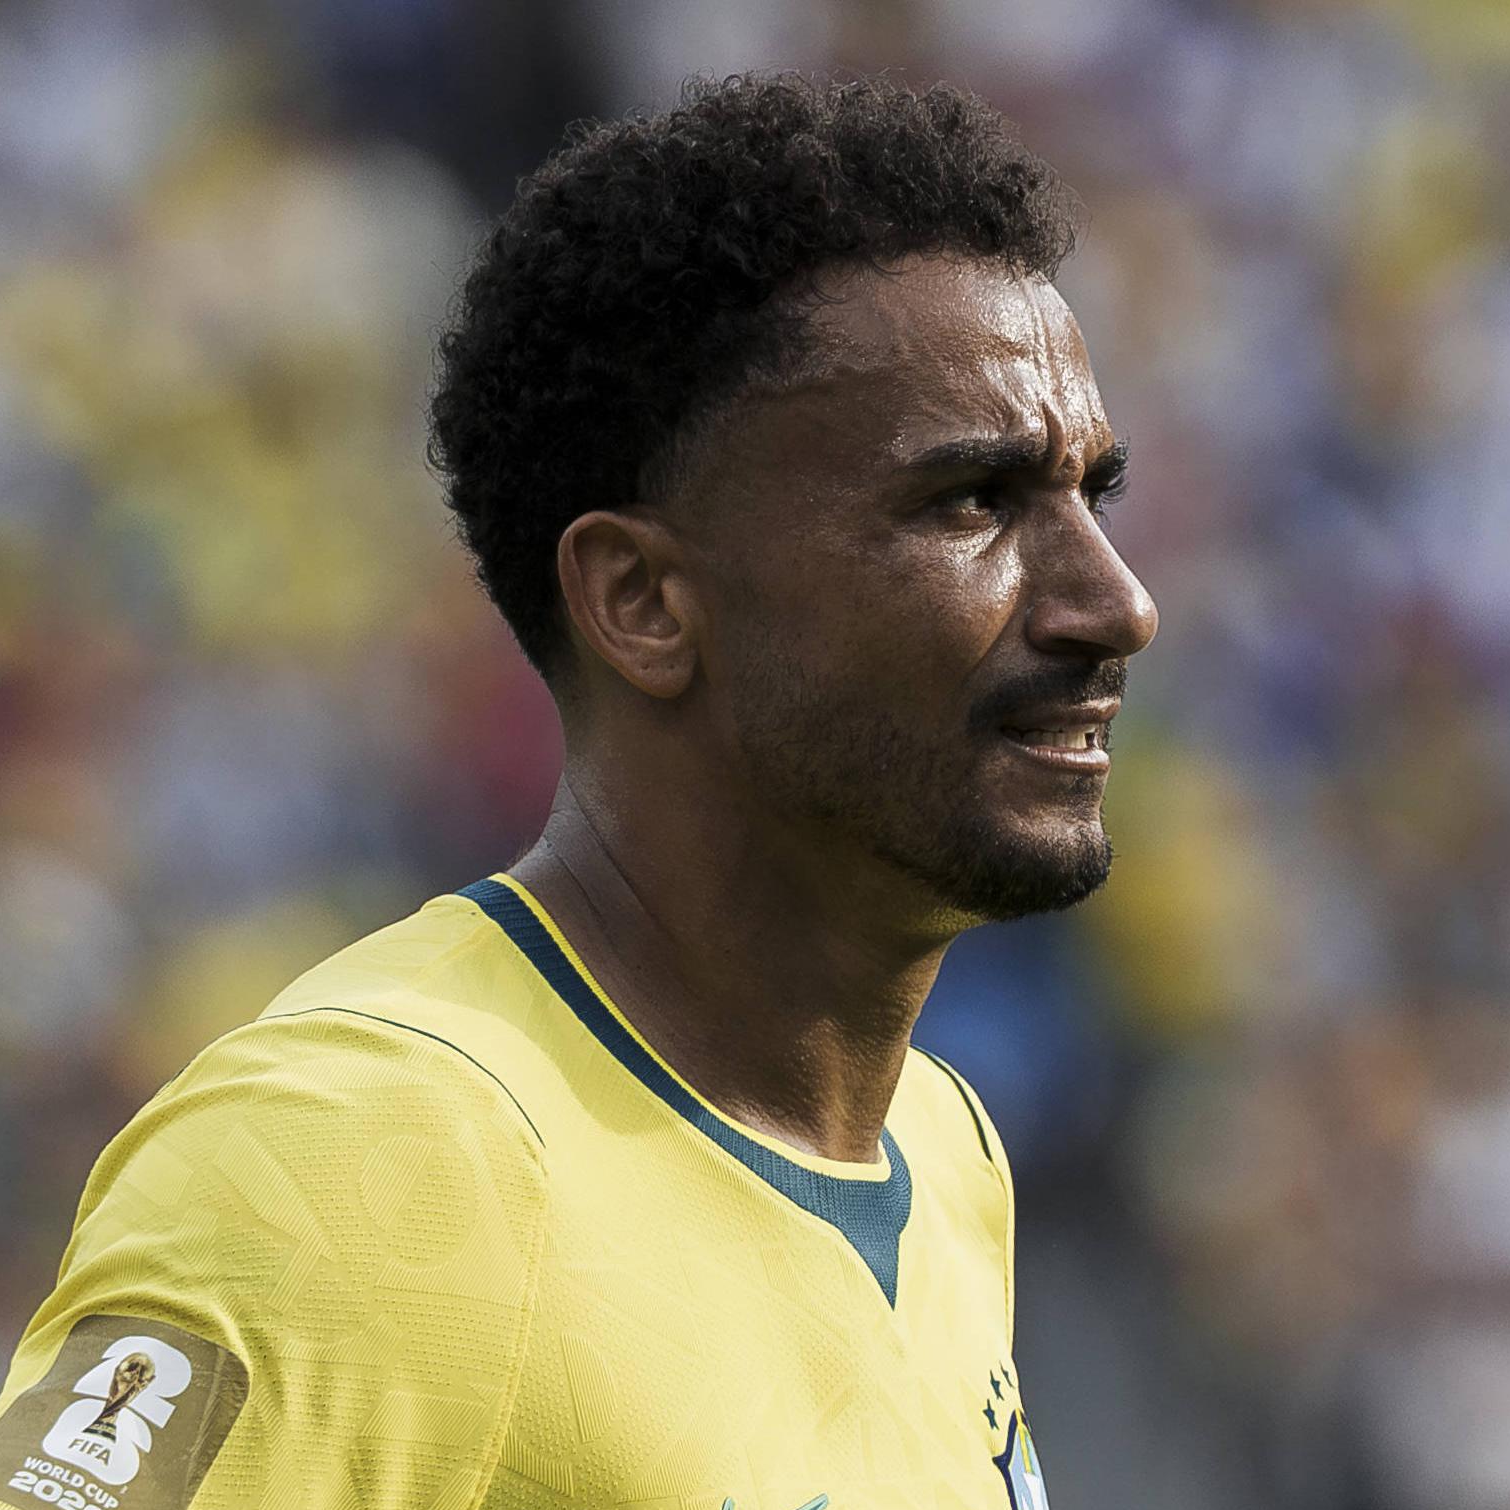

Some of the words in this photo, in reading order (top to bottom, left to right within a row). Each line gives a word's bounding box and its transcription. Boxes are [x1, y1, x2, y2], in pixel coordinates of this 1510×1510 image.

[68, 1438, 111, 1466] FIFA
[23, 1456, 85, 1488] WORLD
[84, 1483, 119, 1509] CUP
